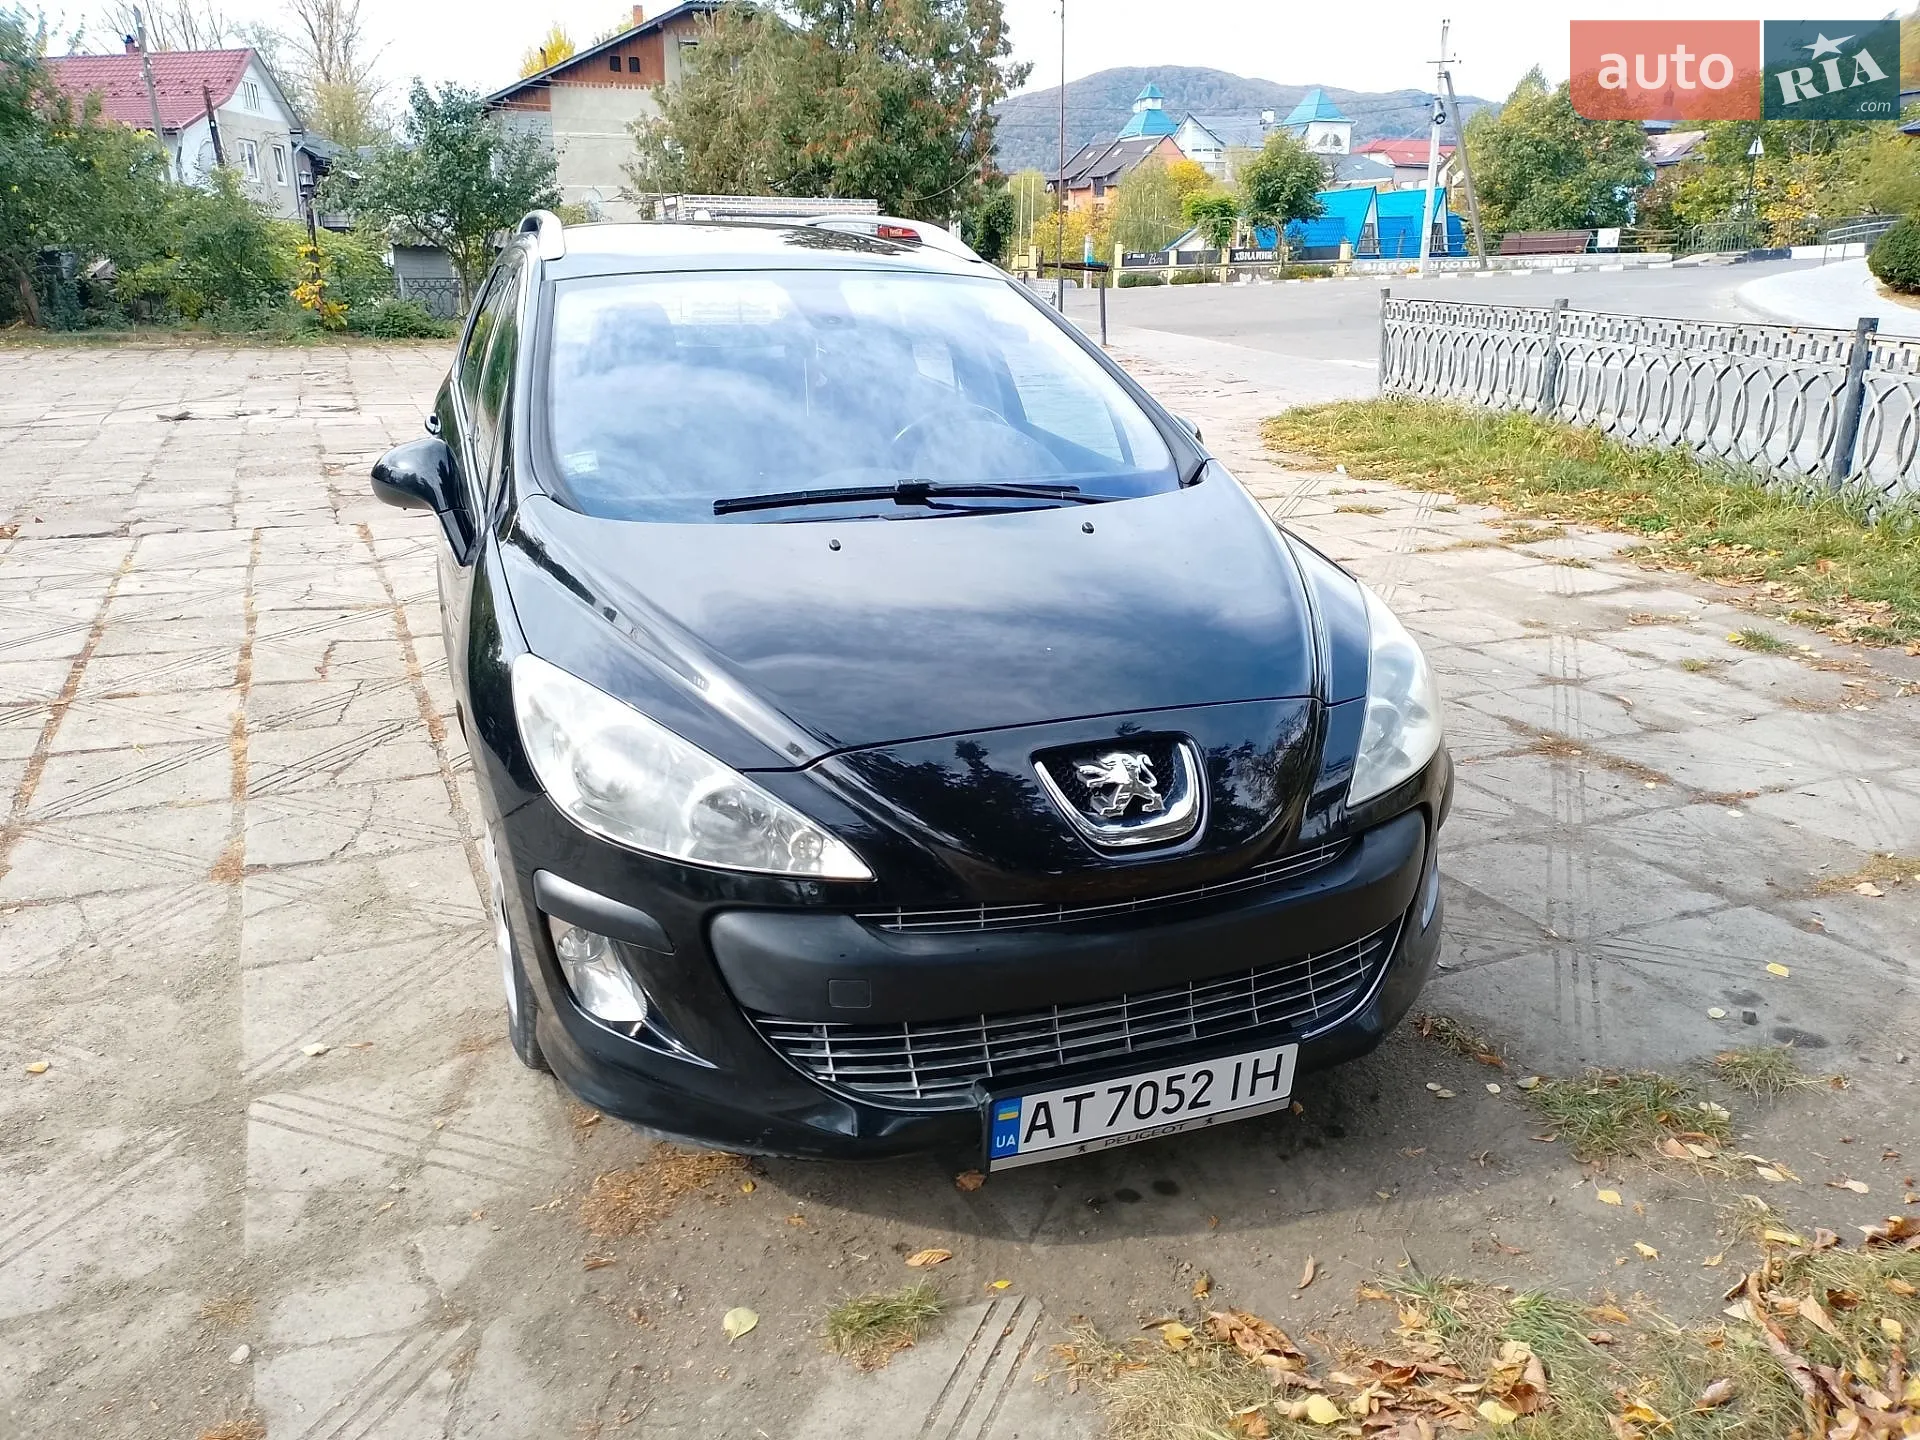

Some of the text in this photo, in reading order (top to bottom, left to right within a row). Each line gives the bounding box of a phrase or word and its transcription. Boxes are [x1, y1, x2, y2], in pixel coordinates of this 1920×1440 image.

[1023, 1053, 1283, 1144] AT 7052 IH
[996, 1134, 1016, 1149] UA
[1104, 1123, 1187, 1147] PEUGEOT
